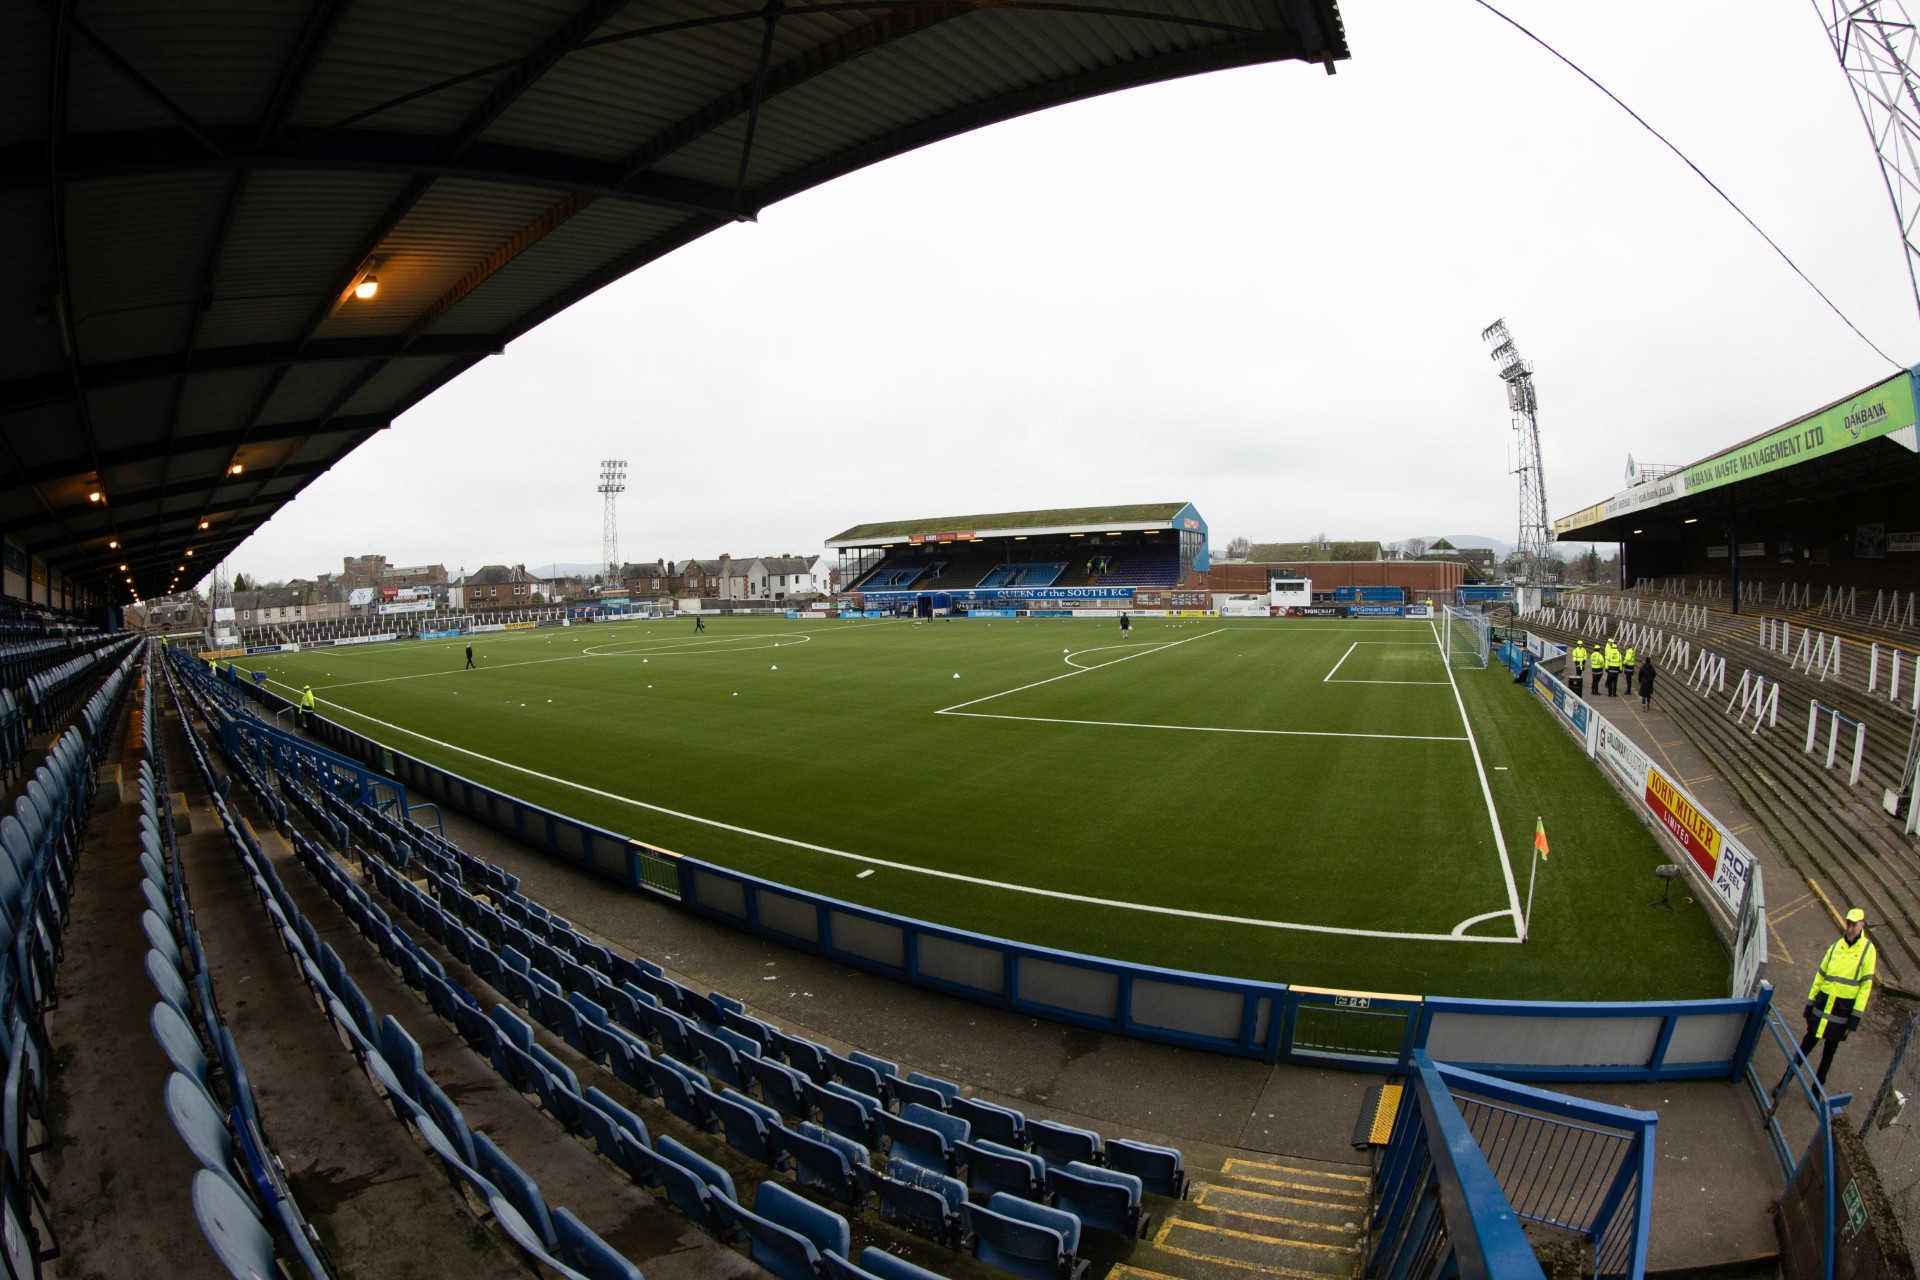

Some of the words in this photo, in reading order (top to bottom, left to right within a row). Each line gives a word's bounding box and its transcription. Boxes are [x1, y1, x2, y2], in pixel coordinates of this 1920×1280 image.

[1844, 401, 1886, 429] OAKBANK
[1684, 466, 1714, 490] OAKBANK
[1714, 458, 1739, 481] WASTE
[1740, 434, 1801, 473] MANAGEMENT
[1804, 425, 1824, 451] LTD
[997, 589, 1034, 599] QUEEN
[1037, 589, 1047, 597] of
[1049, 588, 1065, 597] the
[1067, 588, 1107, 597] SOUTH
[1651, 773, 1674, 807] JOHN
[1675, 797, 1713, 850] MILLER
[1664, 810, 1689, 845] LIMITED
[1721, 863, 1740, 890] STEEL
